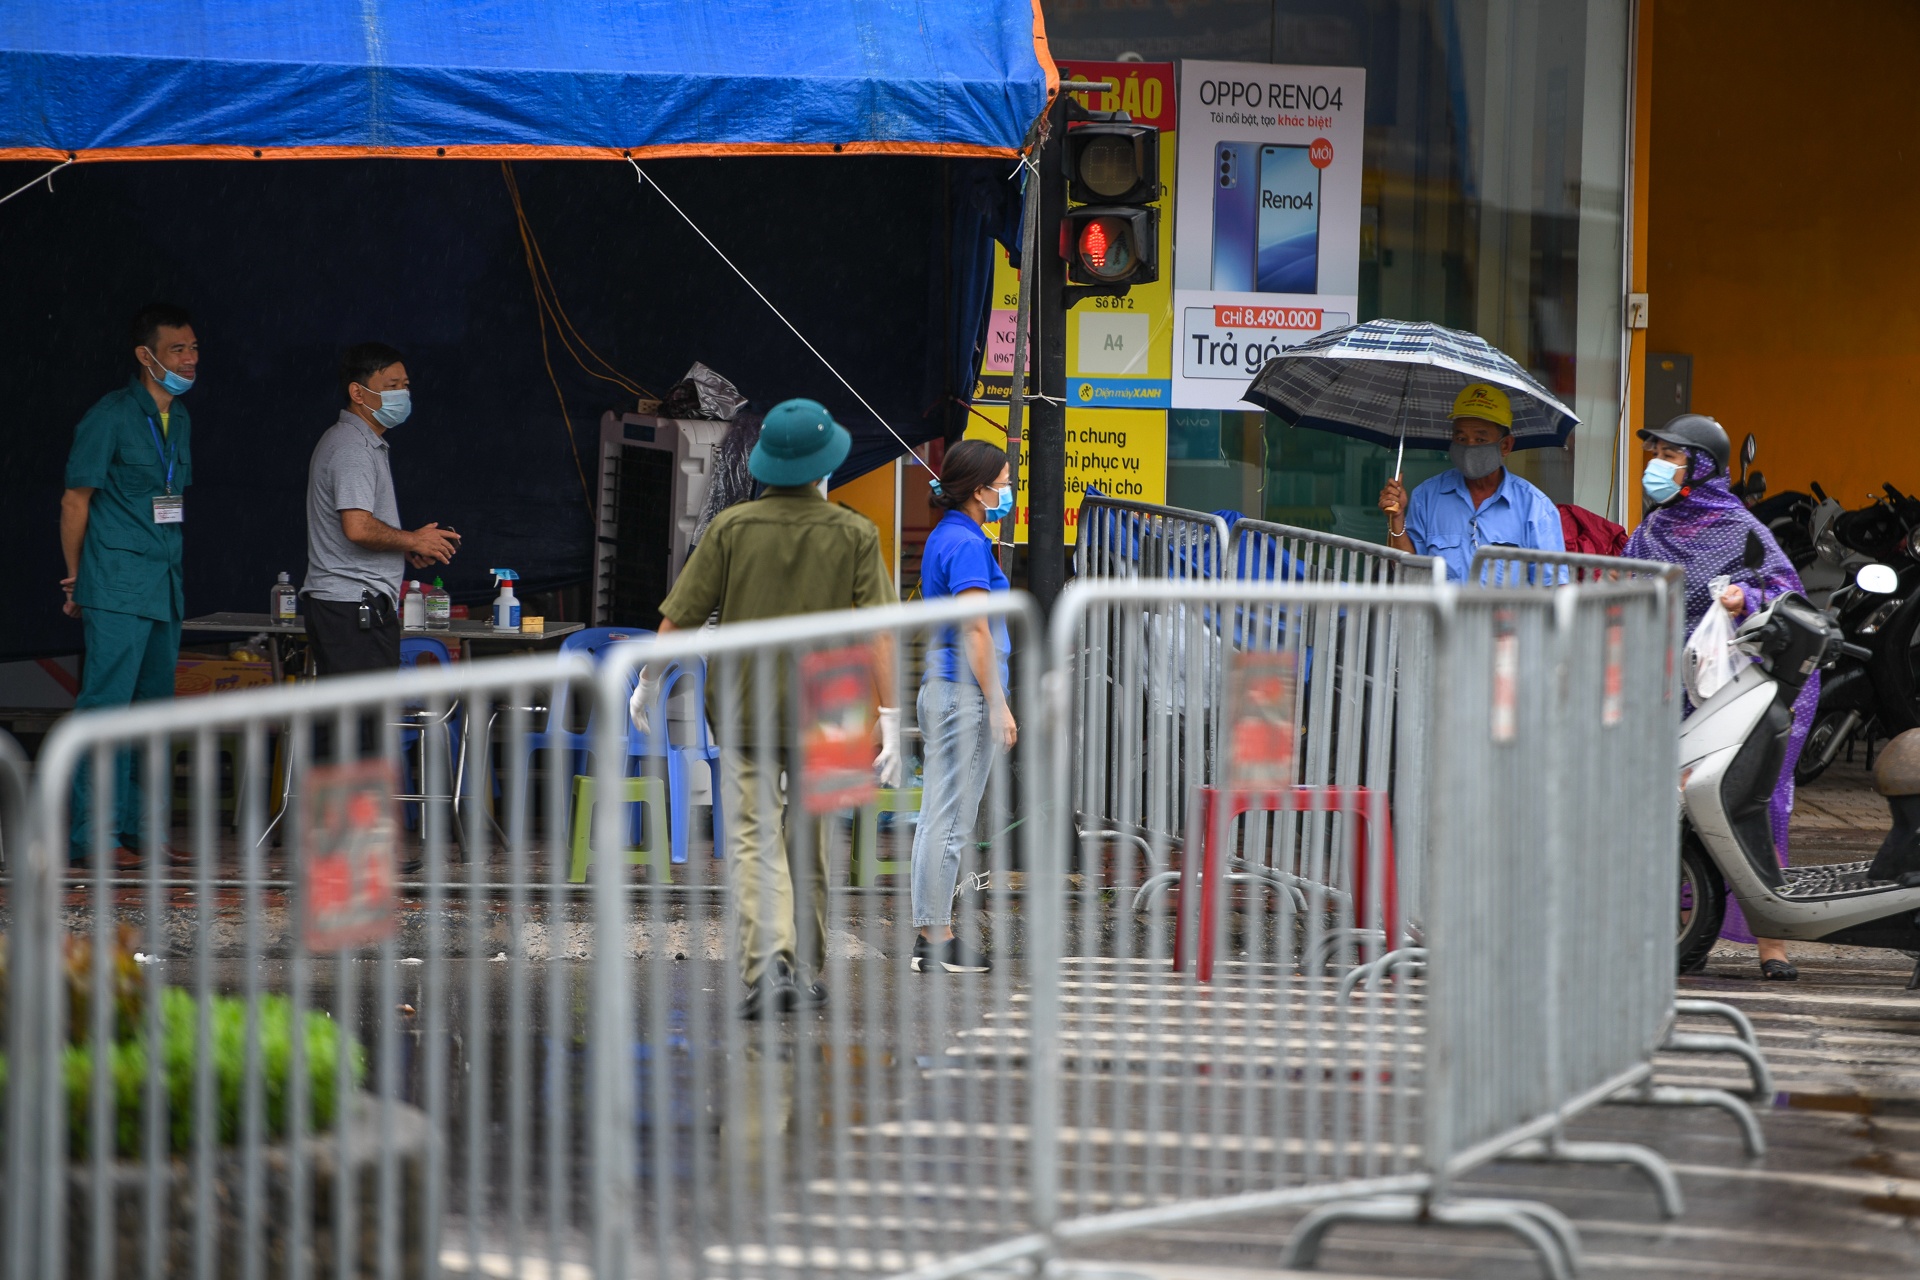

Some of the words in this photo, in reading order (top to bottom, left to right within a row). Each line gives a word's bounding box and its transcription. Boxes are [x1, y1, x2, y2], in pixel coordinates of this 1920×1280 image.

[1101, 71, 1162, 119] BÁO
[1199, 80, 1262, 108] OPPO
[1268, 83, 1343, 111] RENO4
[1210, 111, 1224, 124] Tôi
[1226, 111, 1240, 124] nổi
[1241, 113, 1259, 127] bật,
[1261, 114, 1276, 127] tạo
[1278, 114, 1305, 127] khác
[1308, 115, 1332, 130] biệt!
[1311, 144, 1332, 160] MỚI
[1262, 189, 1313, 210] Reno4
[1111, 297, 1125, 309] ĐT
[1127, 298, 1134, 309] 2
[1221, 307, 1242, 325] CHỈ
[1244, 309, 1317, 328] 8.490.000
[1103, 333, 1123, 351] A4
[1192, 331, 1237, 366] Trả
[1245, 335, 1295, 375] gó
[1133, 387, 1162, 399] XANH
[1175, 416, 1210, 427] vivo
[1080, 427, 1127, 448] chung
[1065, 450, 1079, 468] hỉ
[1082, 452, 1119, 472] phục
[1122, 457, 1140, 474] vụ
[1116, 479, 1143, 495] cho
